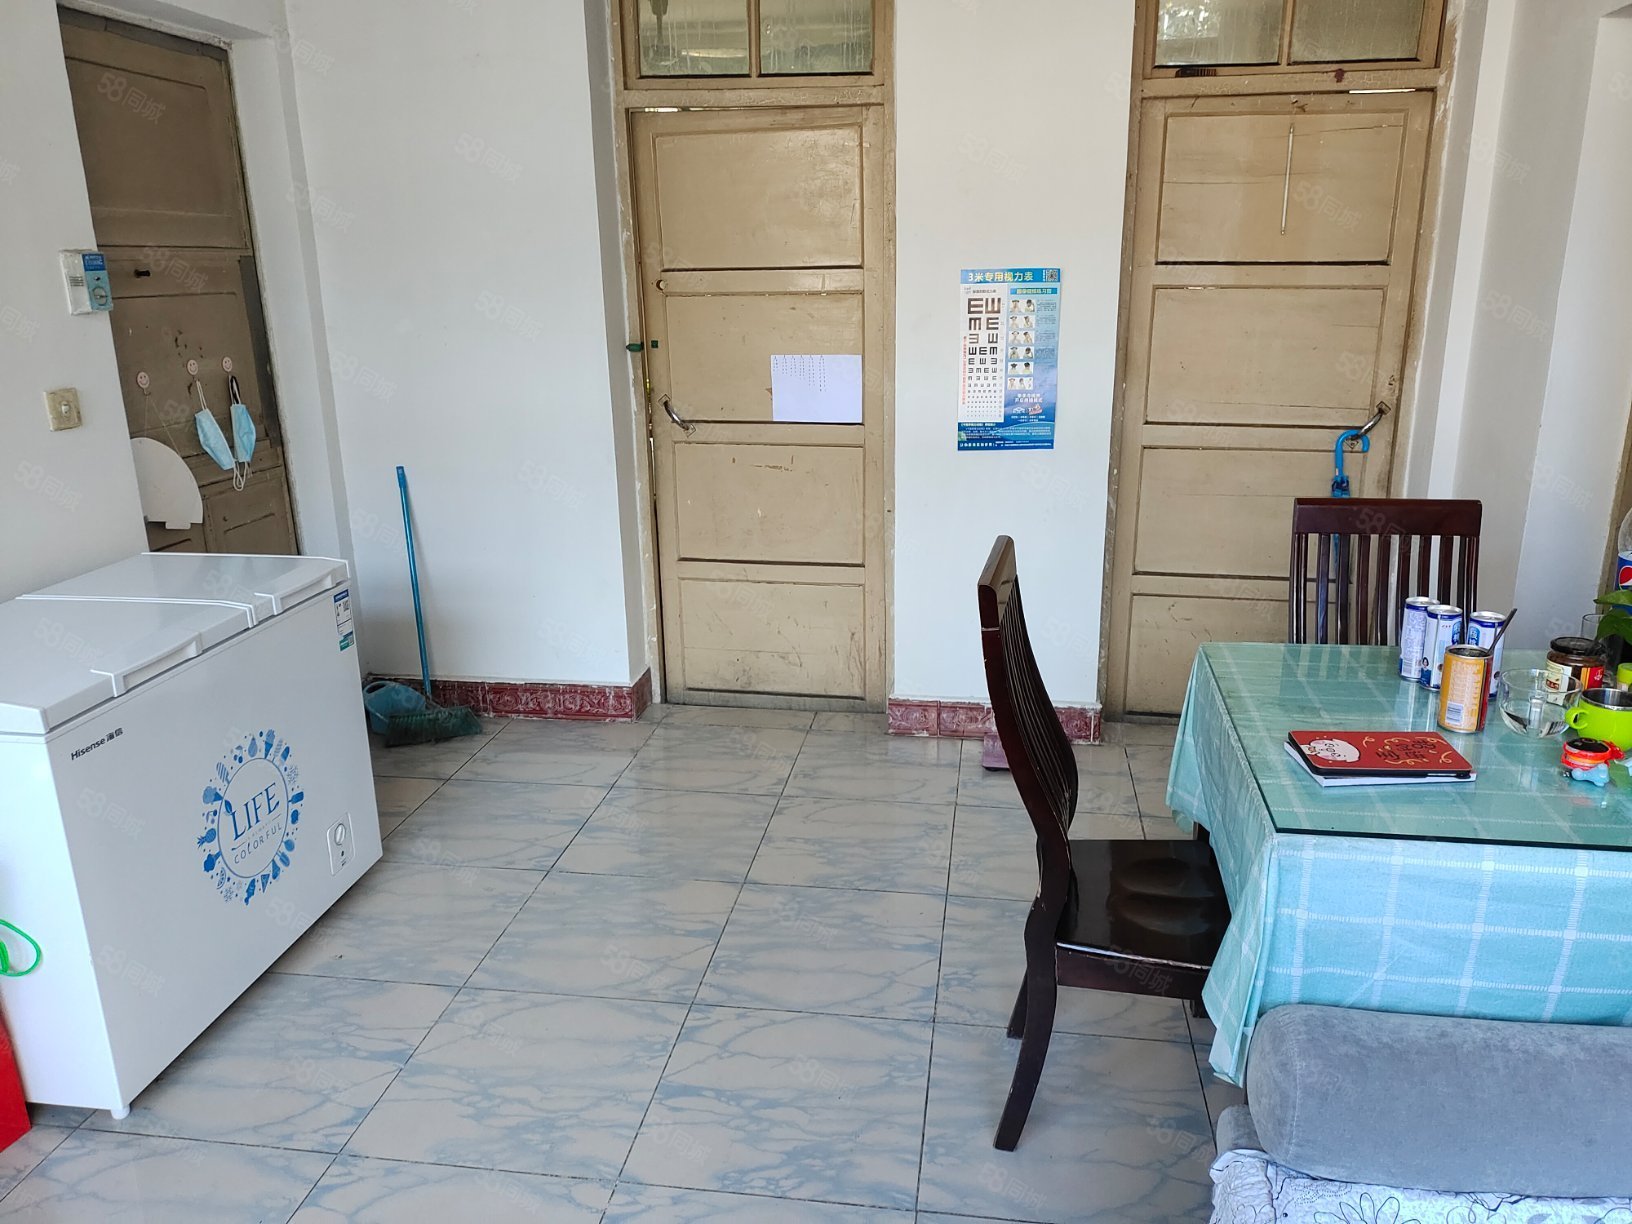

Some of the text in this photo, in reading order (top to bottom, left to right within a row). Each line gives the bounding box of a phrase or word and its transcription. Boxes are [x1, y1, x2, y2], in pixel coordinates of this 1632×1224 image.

[968, 272, 1034, 282] 3米专用视力表
[71, 738, 105, 760] Hisense
[230, 783, 279, 841] LIFE
[234, 822, 282, 864] COLORFUL
